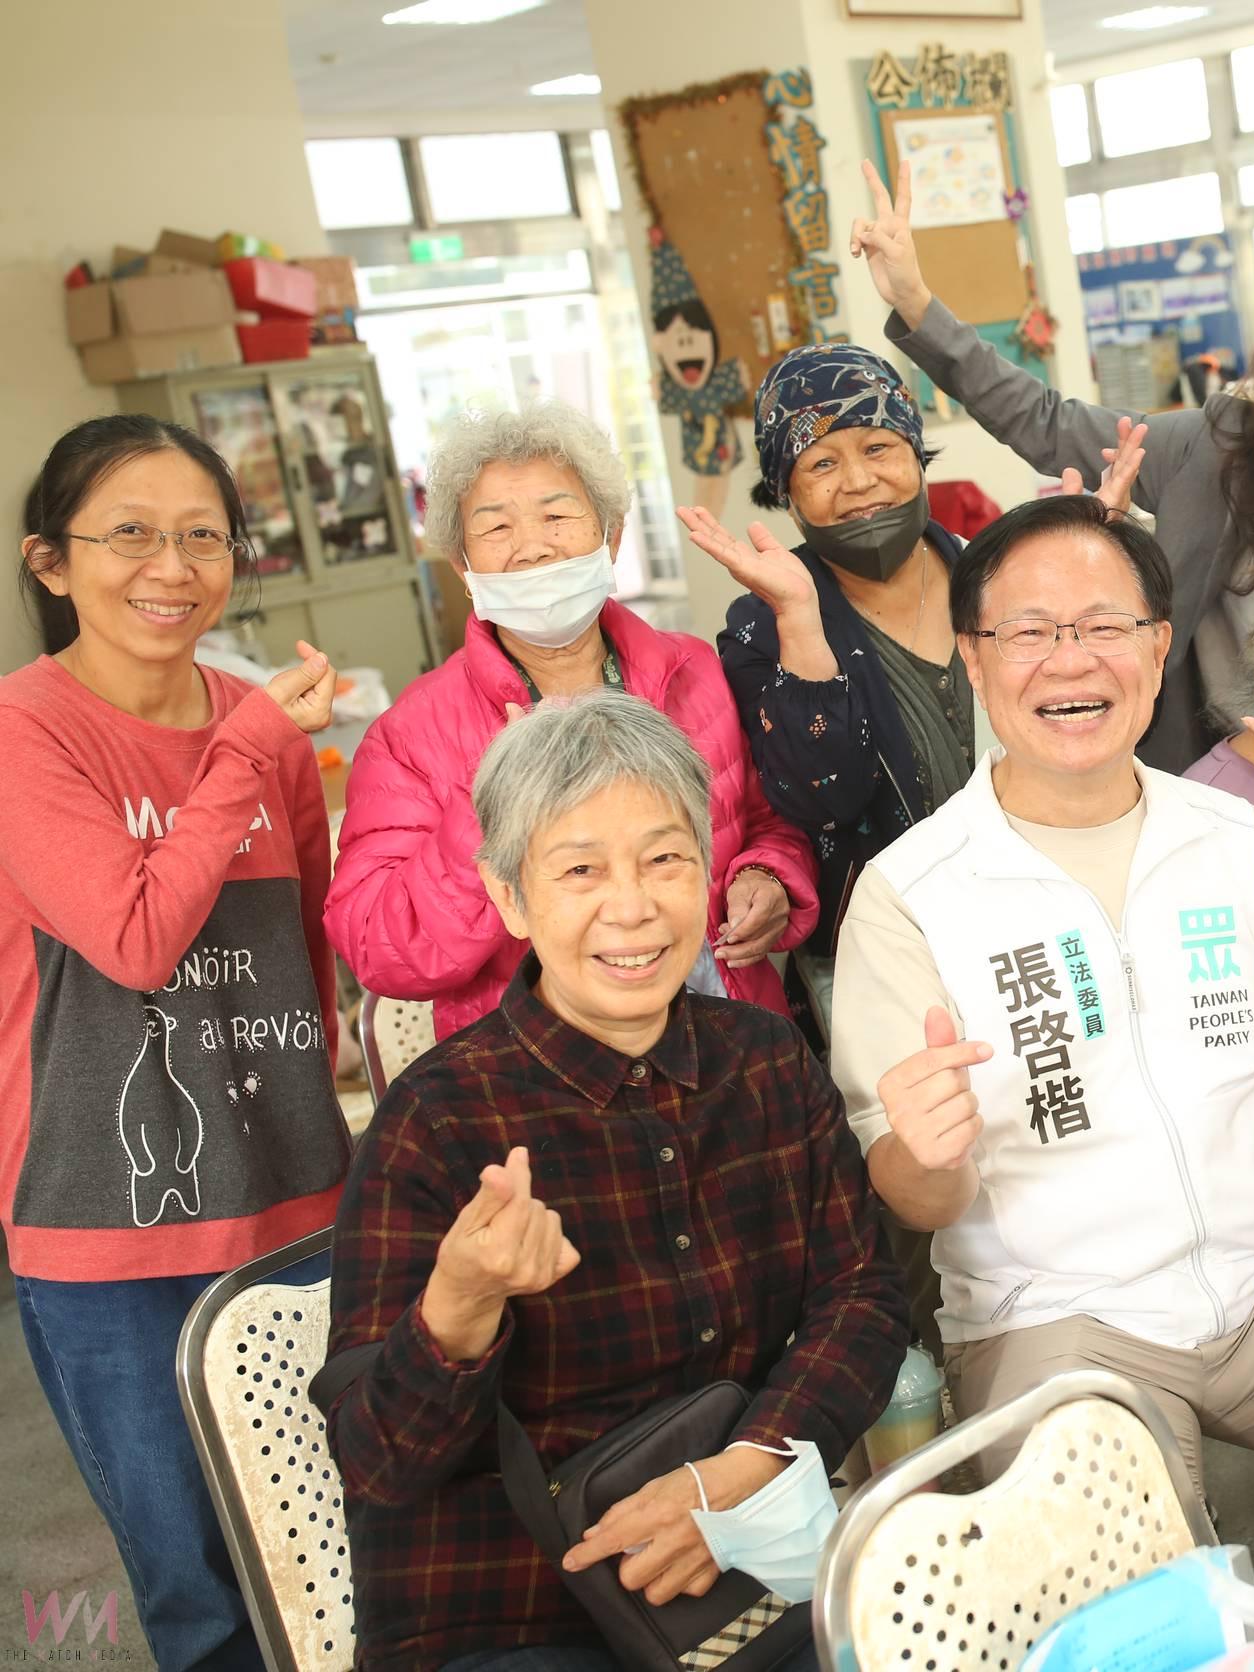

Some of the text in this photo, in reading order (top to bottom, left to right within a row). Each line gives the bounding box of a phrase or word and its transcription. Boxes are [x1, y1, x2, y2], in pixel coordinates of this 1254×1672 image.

[867, 42, 1012, 110] 公佈欄
[763, 65, 850, 346] 心情留言
[1061, 937, 1105, 1039] 立法委員
[1191, 989, 1249, 1010] TAIWAN
[1189, 1009, 1254, 1031] PEOPLE'S
[1204, 1030, 1250, 1049] PARTY
